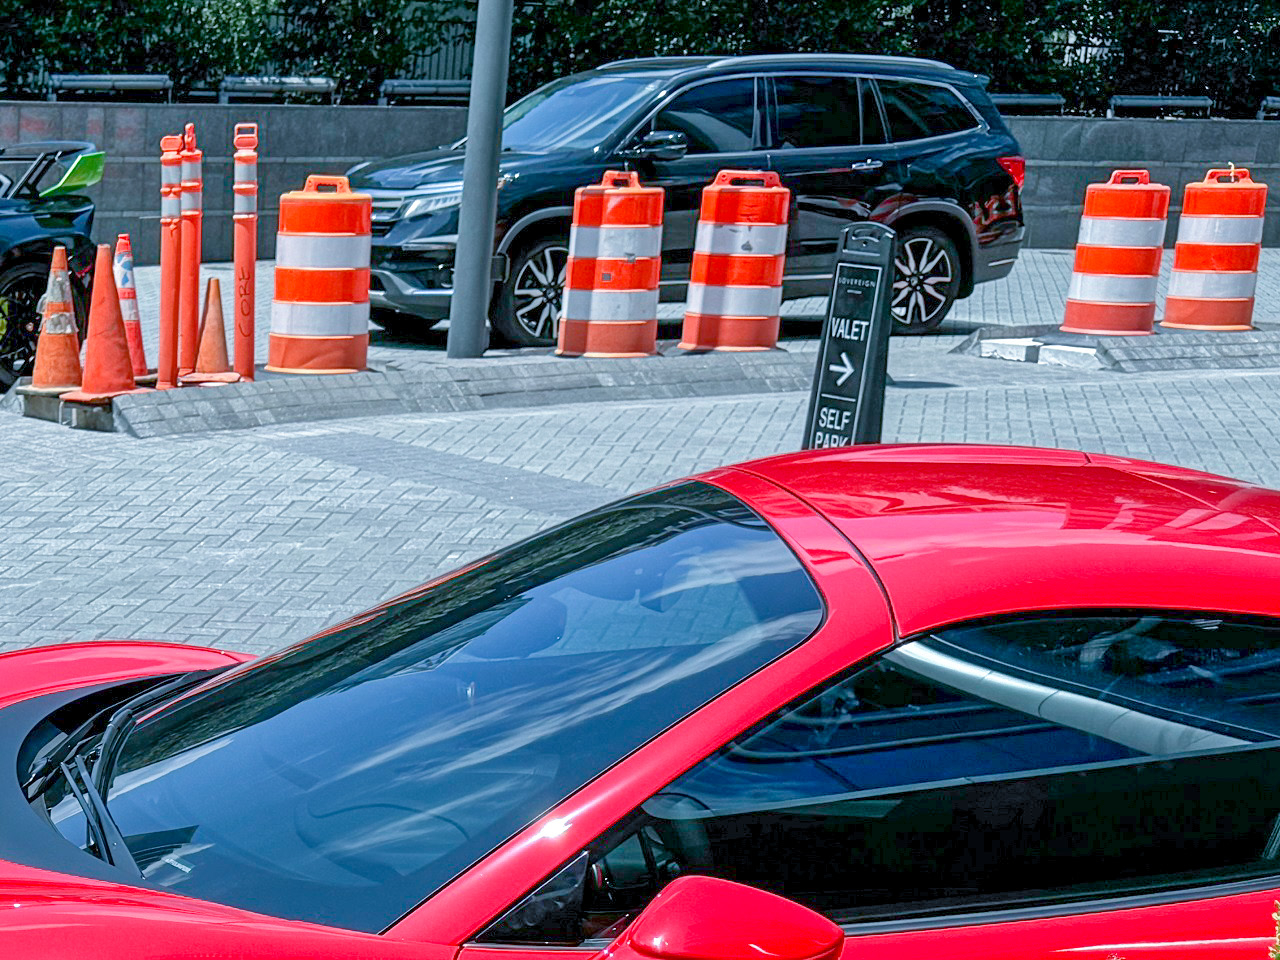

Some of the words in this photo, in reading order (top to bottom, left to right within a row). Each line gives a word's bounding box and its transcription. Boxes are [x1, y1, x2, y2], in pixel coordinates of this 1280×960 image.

[838, 277, 876, 288] SOVEREIGN
[831, 317, 870, 341] VALET
[819, 407, 852, 431] SELF
